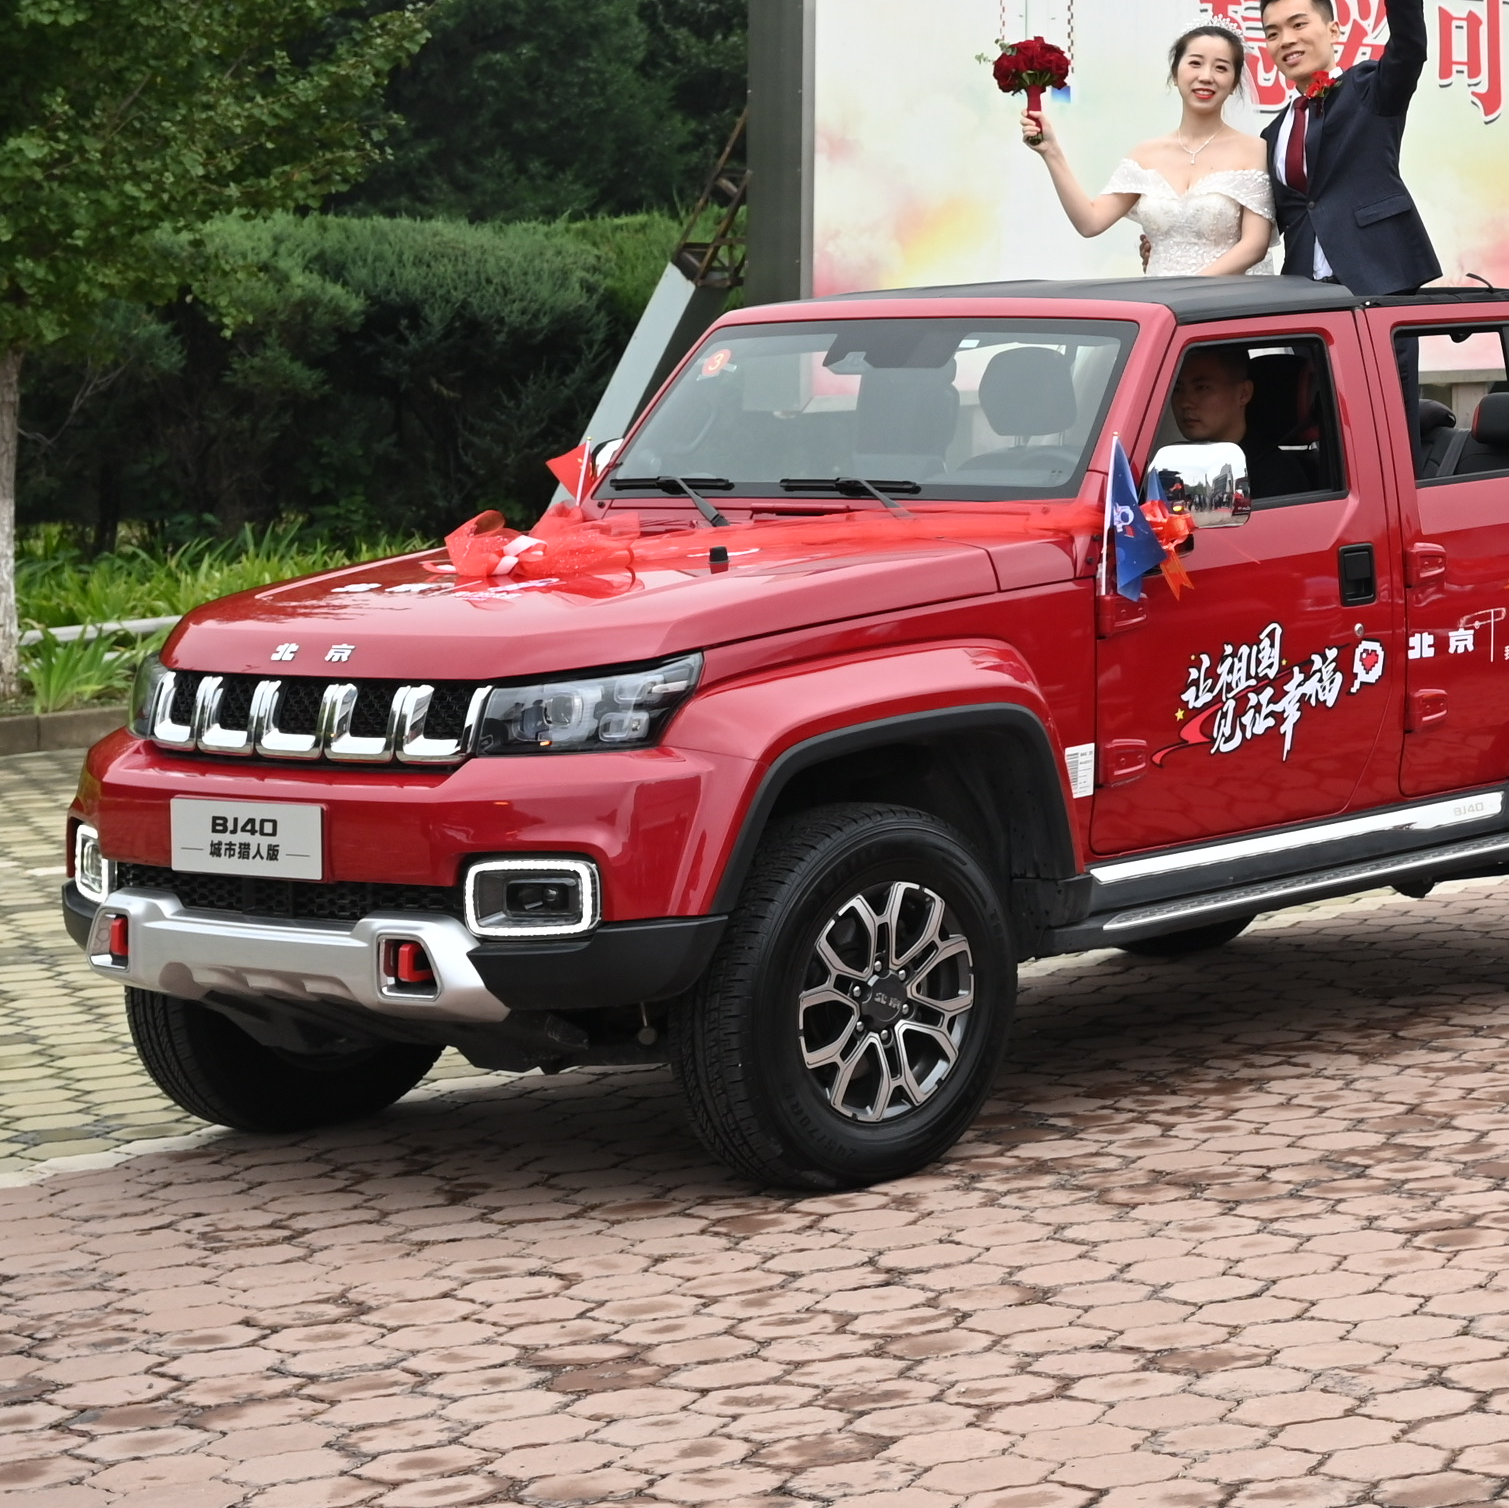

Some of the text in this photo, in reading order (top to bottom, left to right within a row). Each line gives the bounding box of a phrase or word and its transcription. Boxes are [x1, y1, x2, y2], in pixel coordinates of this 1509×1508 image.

[708, 353, 724, 370] 3
[270, 643, 356, 662] 北京
[1408, 628, 1475, 659] 北京
[1180, 621, 1284, 709] 让祖国
[1210, 647, 1344, 762] 见证幸福
[1454, 802, 1484, 816] BJ40
[211, 816, 278, 837] BJ40
[209, 840, 280, 861] 城市猎人版
